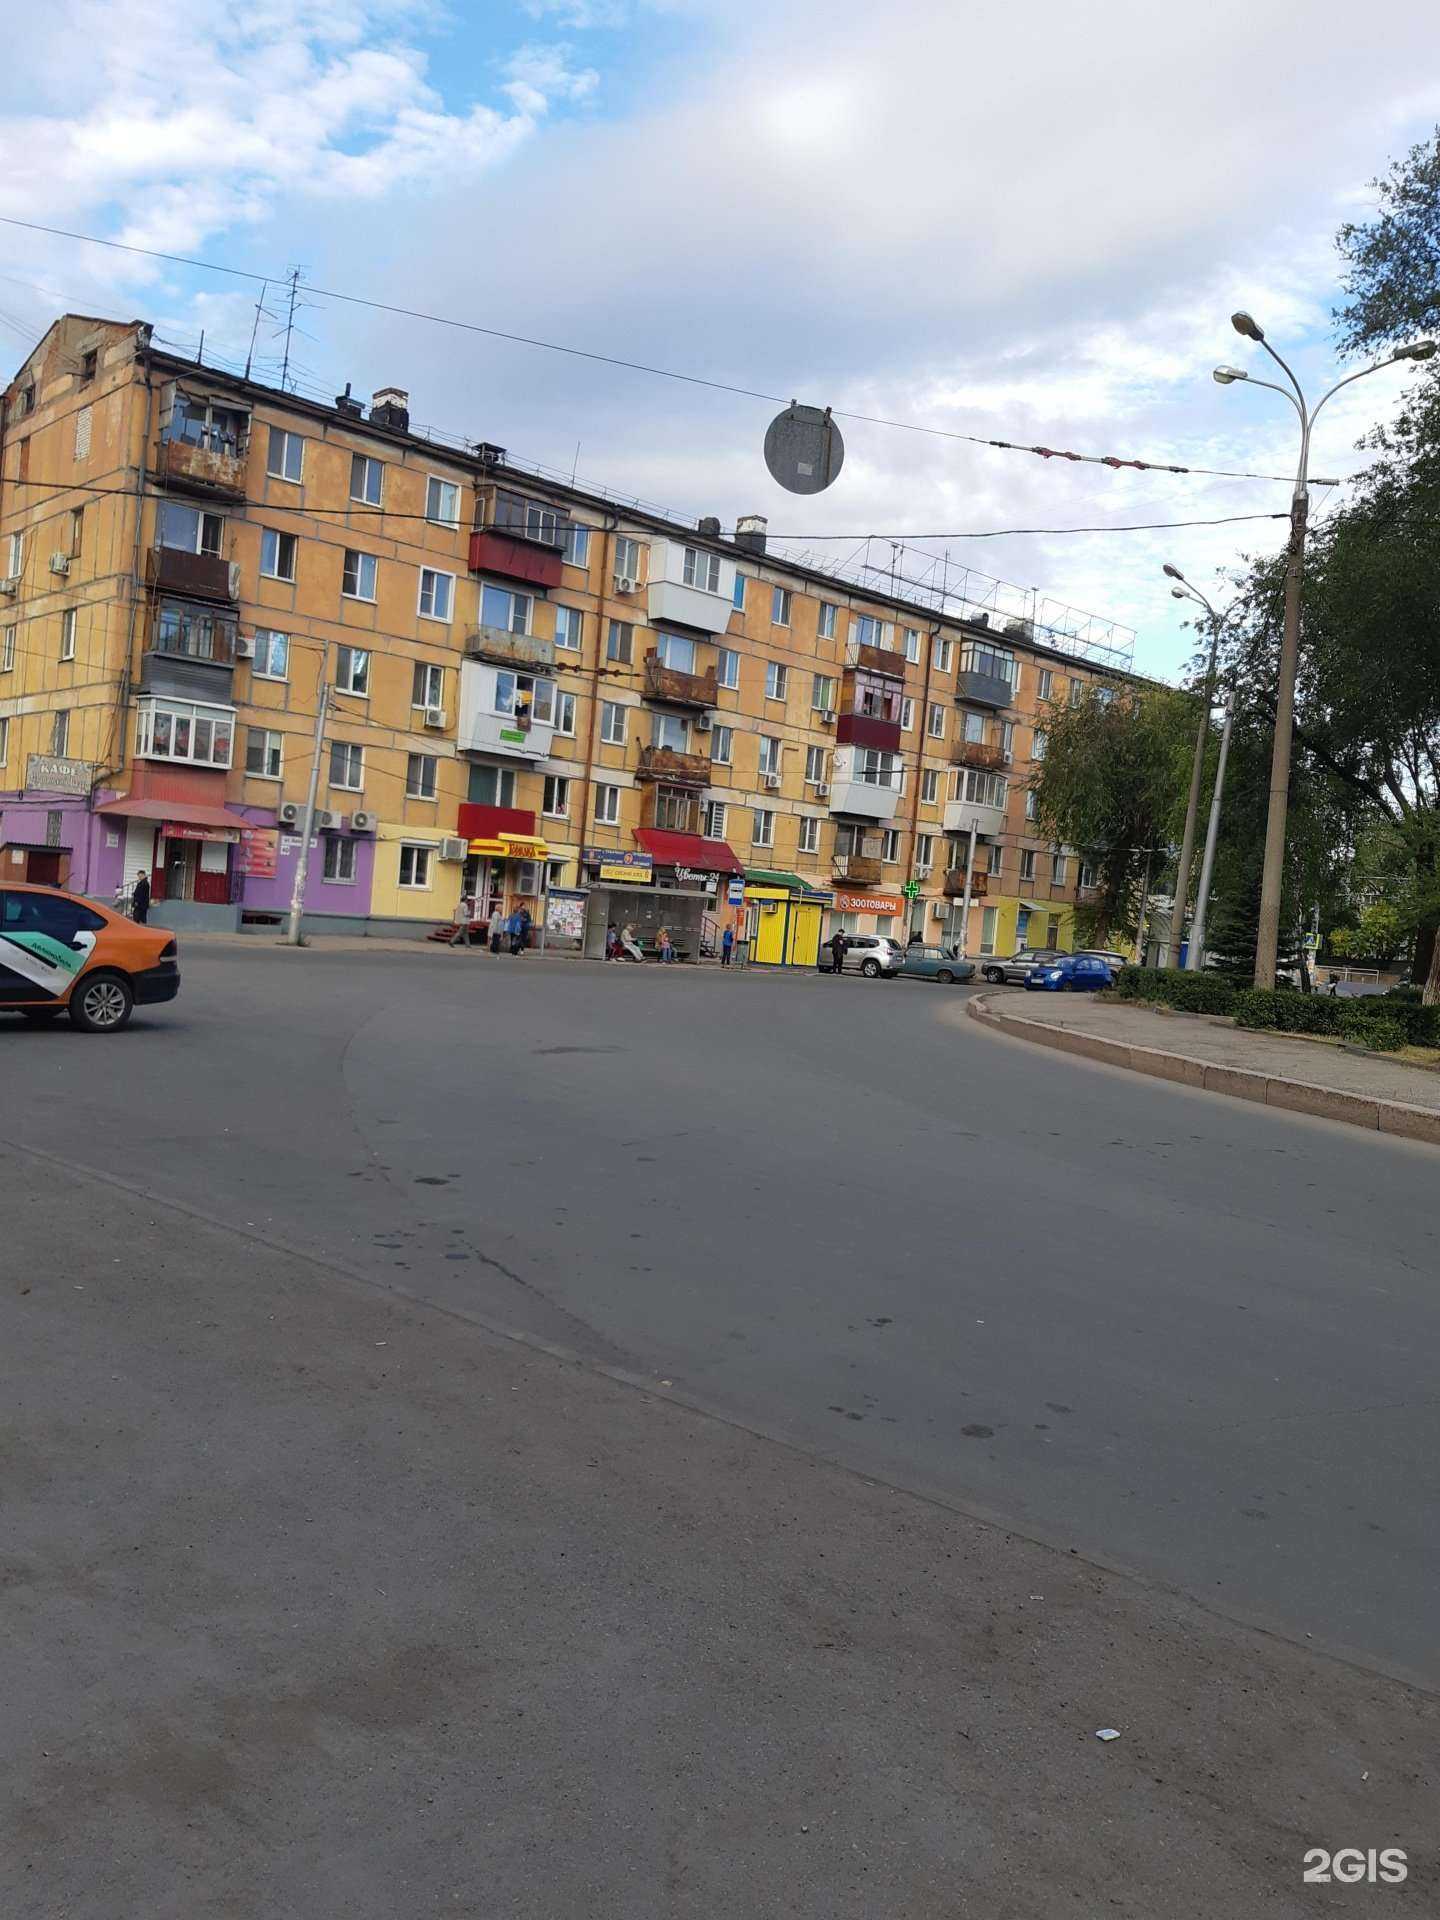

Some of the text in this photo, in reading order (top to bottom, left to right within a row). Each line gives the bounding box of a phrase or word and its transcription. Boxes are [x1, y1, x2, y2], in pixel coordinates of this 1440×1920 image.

[40, 763, 79, 776] КАФЕ
[674, 866, 720, 882] Цветы 24
[850, 898, 897, 911] ЗООТОВАРЫ
